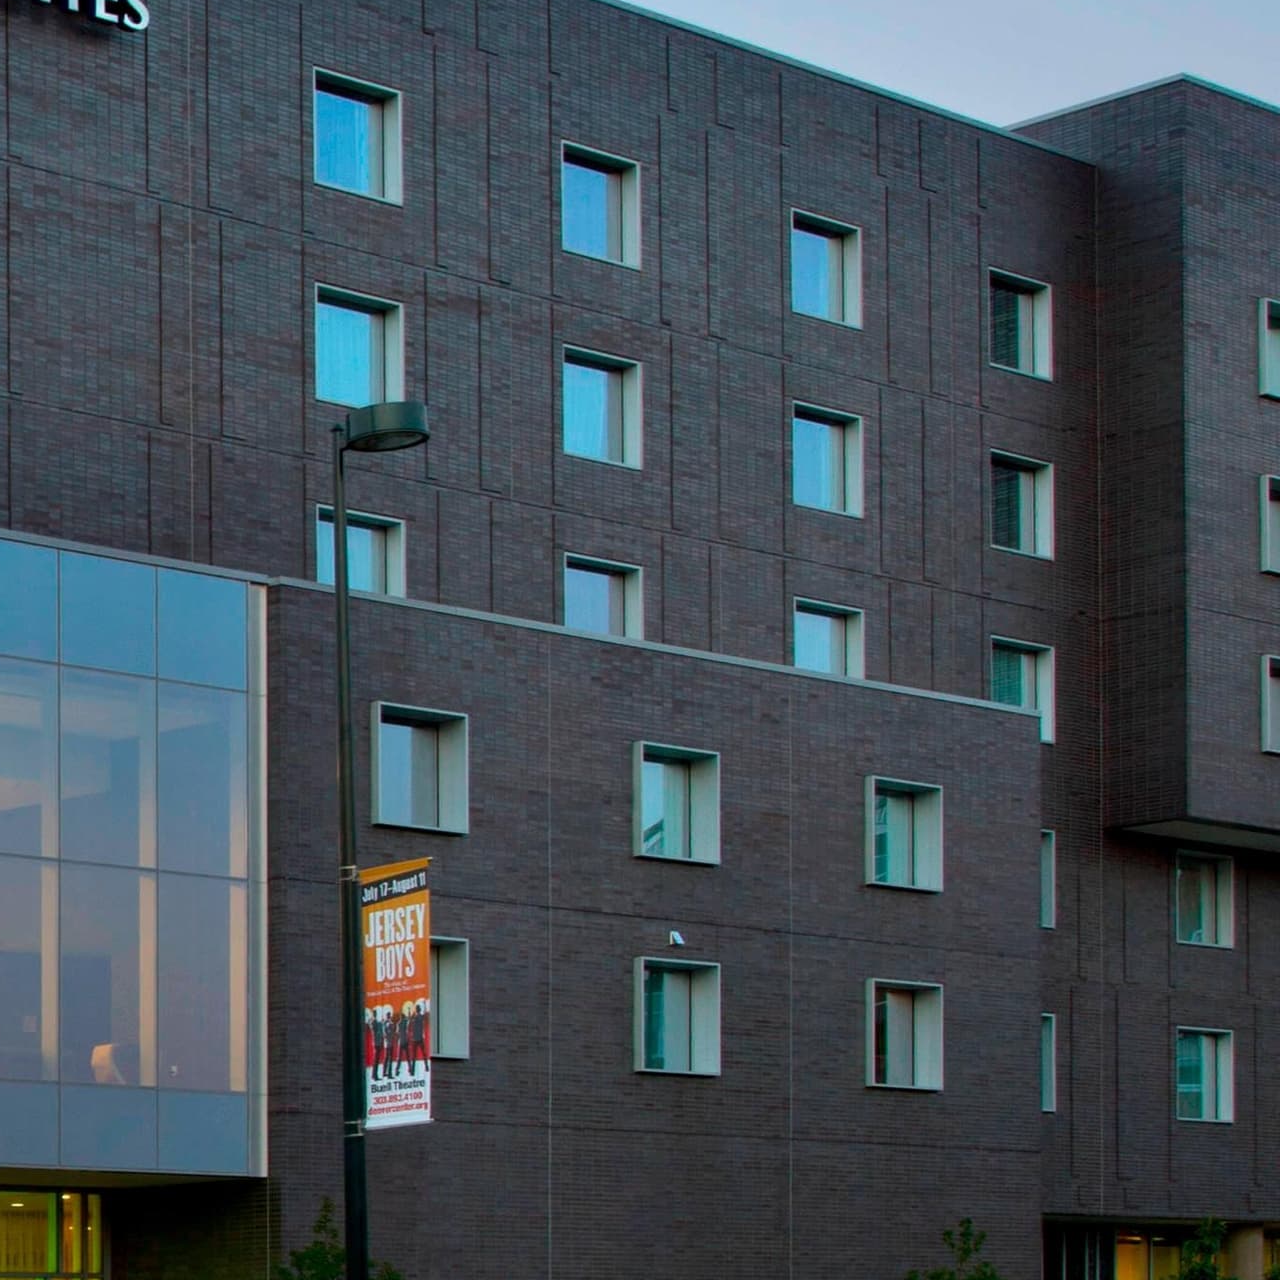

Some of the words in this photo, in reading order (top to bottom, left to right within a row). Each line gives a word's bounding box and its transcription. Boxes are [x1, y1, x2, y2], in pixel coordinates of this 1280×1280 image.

[362, 887, 378, 902] July
[418, 872, 426, 887] 11
[365, 903, 425, 947] JERSEY
[376, 942, 415, 983] BOYS
[393, 1080, 425, 1090] Theatre
